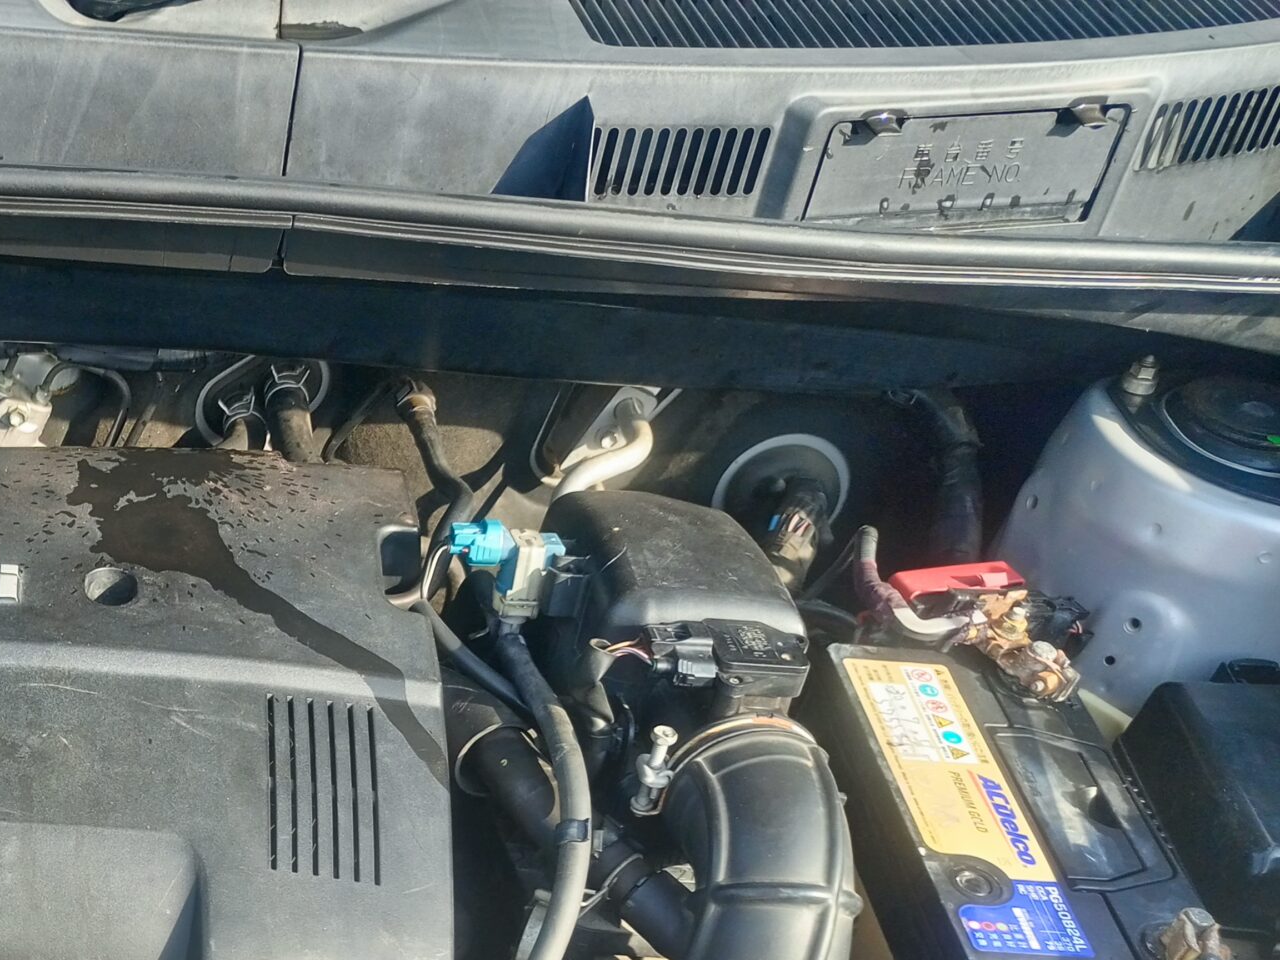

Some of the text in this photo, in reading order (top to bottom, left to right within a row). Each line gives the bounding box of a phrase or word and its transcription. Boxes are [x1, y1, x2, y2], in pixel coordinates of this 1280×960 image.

[898, 163, 982, 188] FRAME
[948, 771, 977, 810] PREMIUM
[977, 774, 1036, 865] ACDelco
[1044, 886, 1088, 952] PG50B24L
